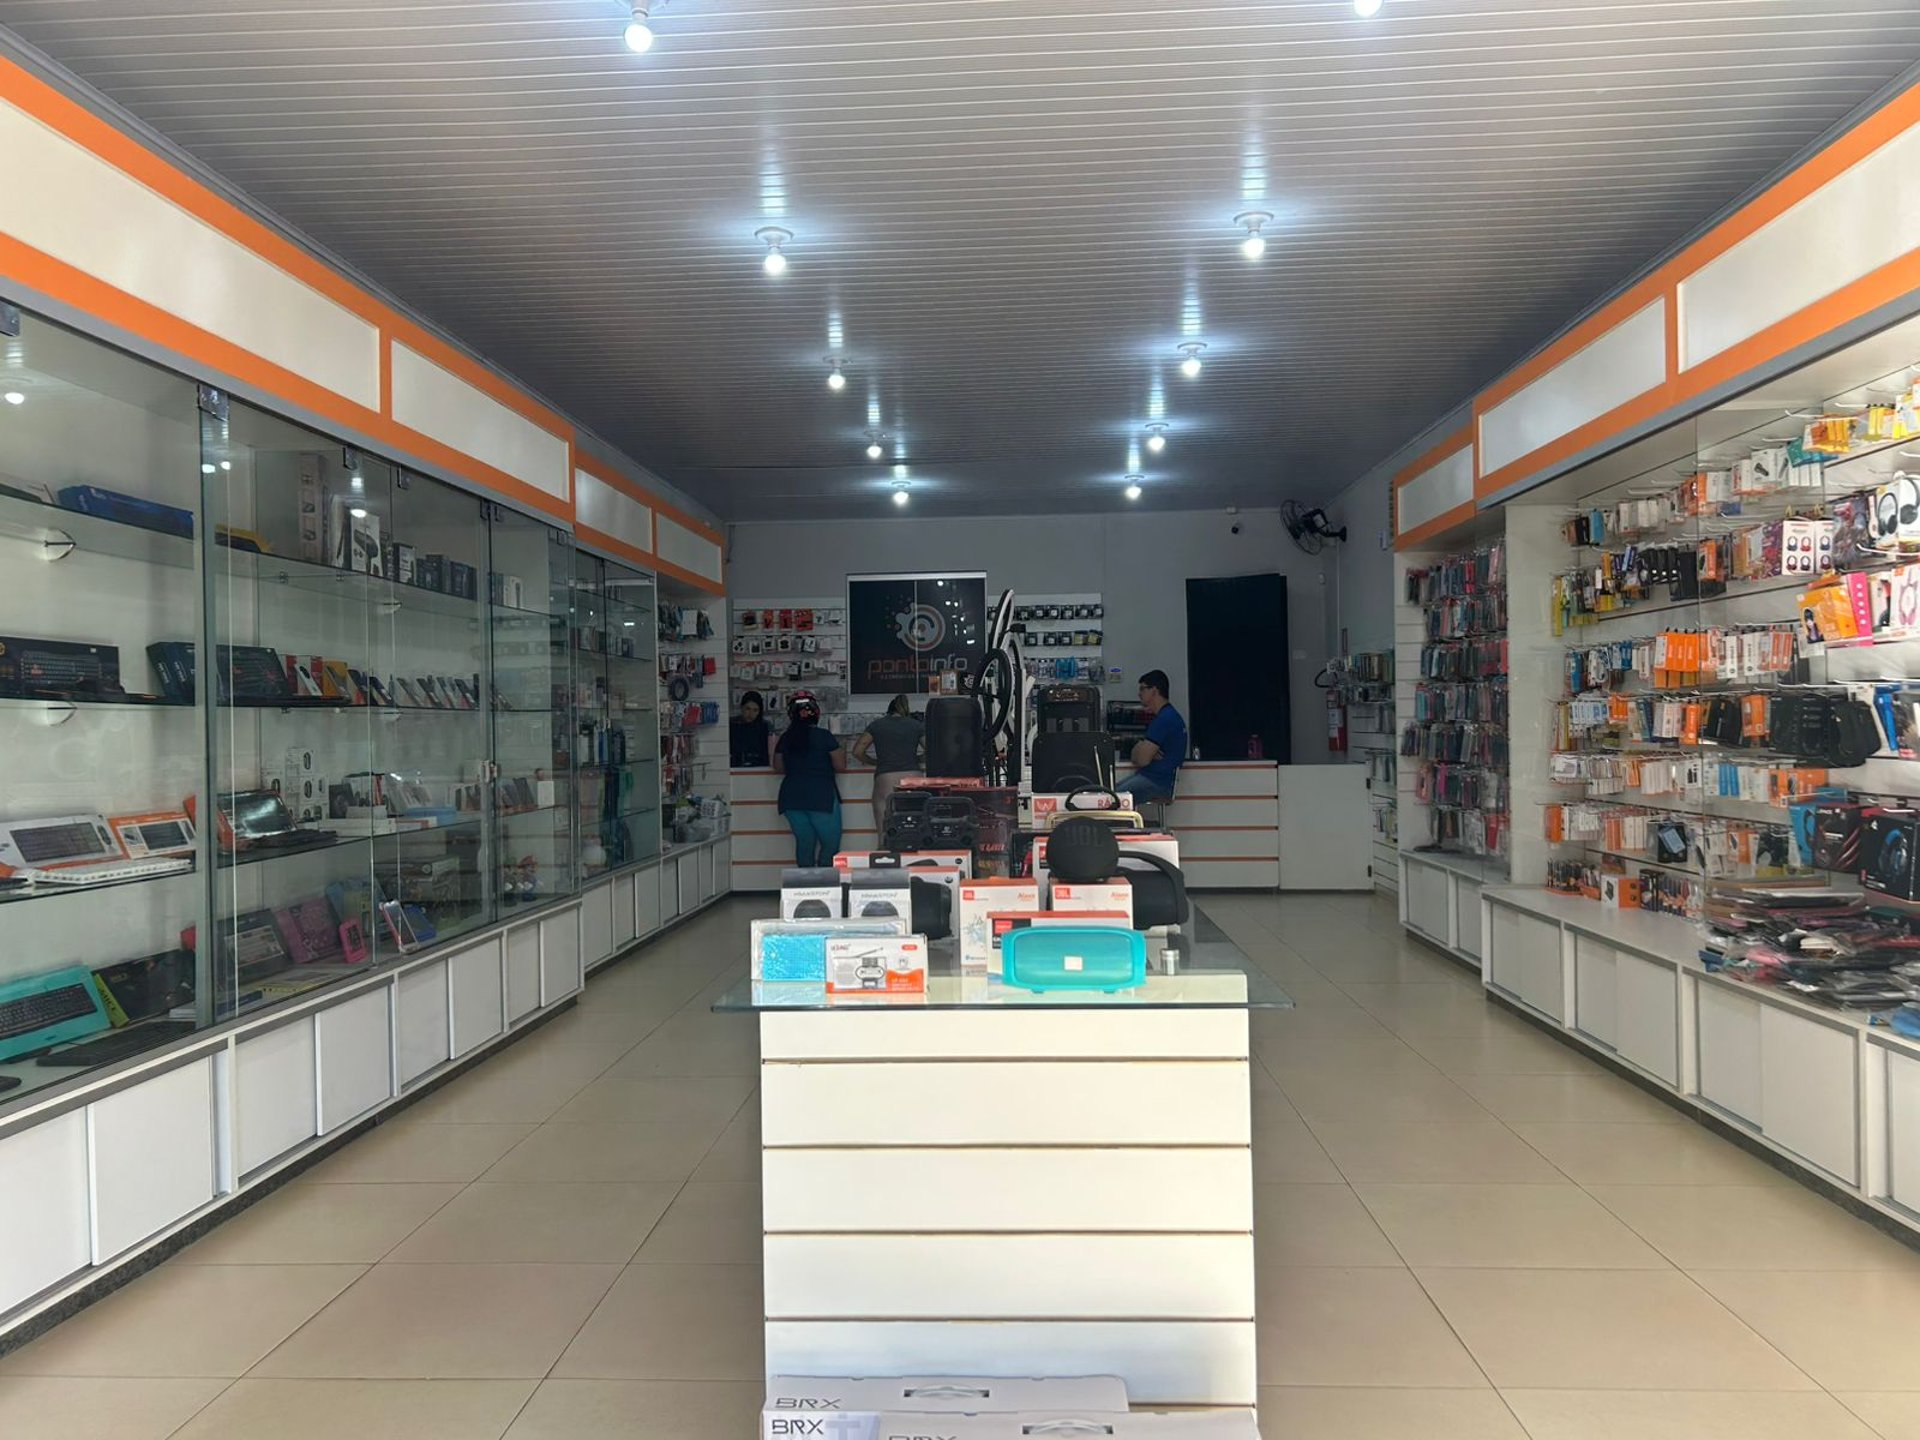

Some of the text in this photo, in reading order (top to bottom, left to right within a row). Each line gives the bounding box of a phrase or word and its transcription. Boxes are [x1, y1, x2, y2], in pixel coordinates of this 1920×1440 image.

[1098, 797, 1131, 807] RÁO
[775, 1397, 842, 1409] BRX
[772, 1419, 825, 1435] BRX
